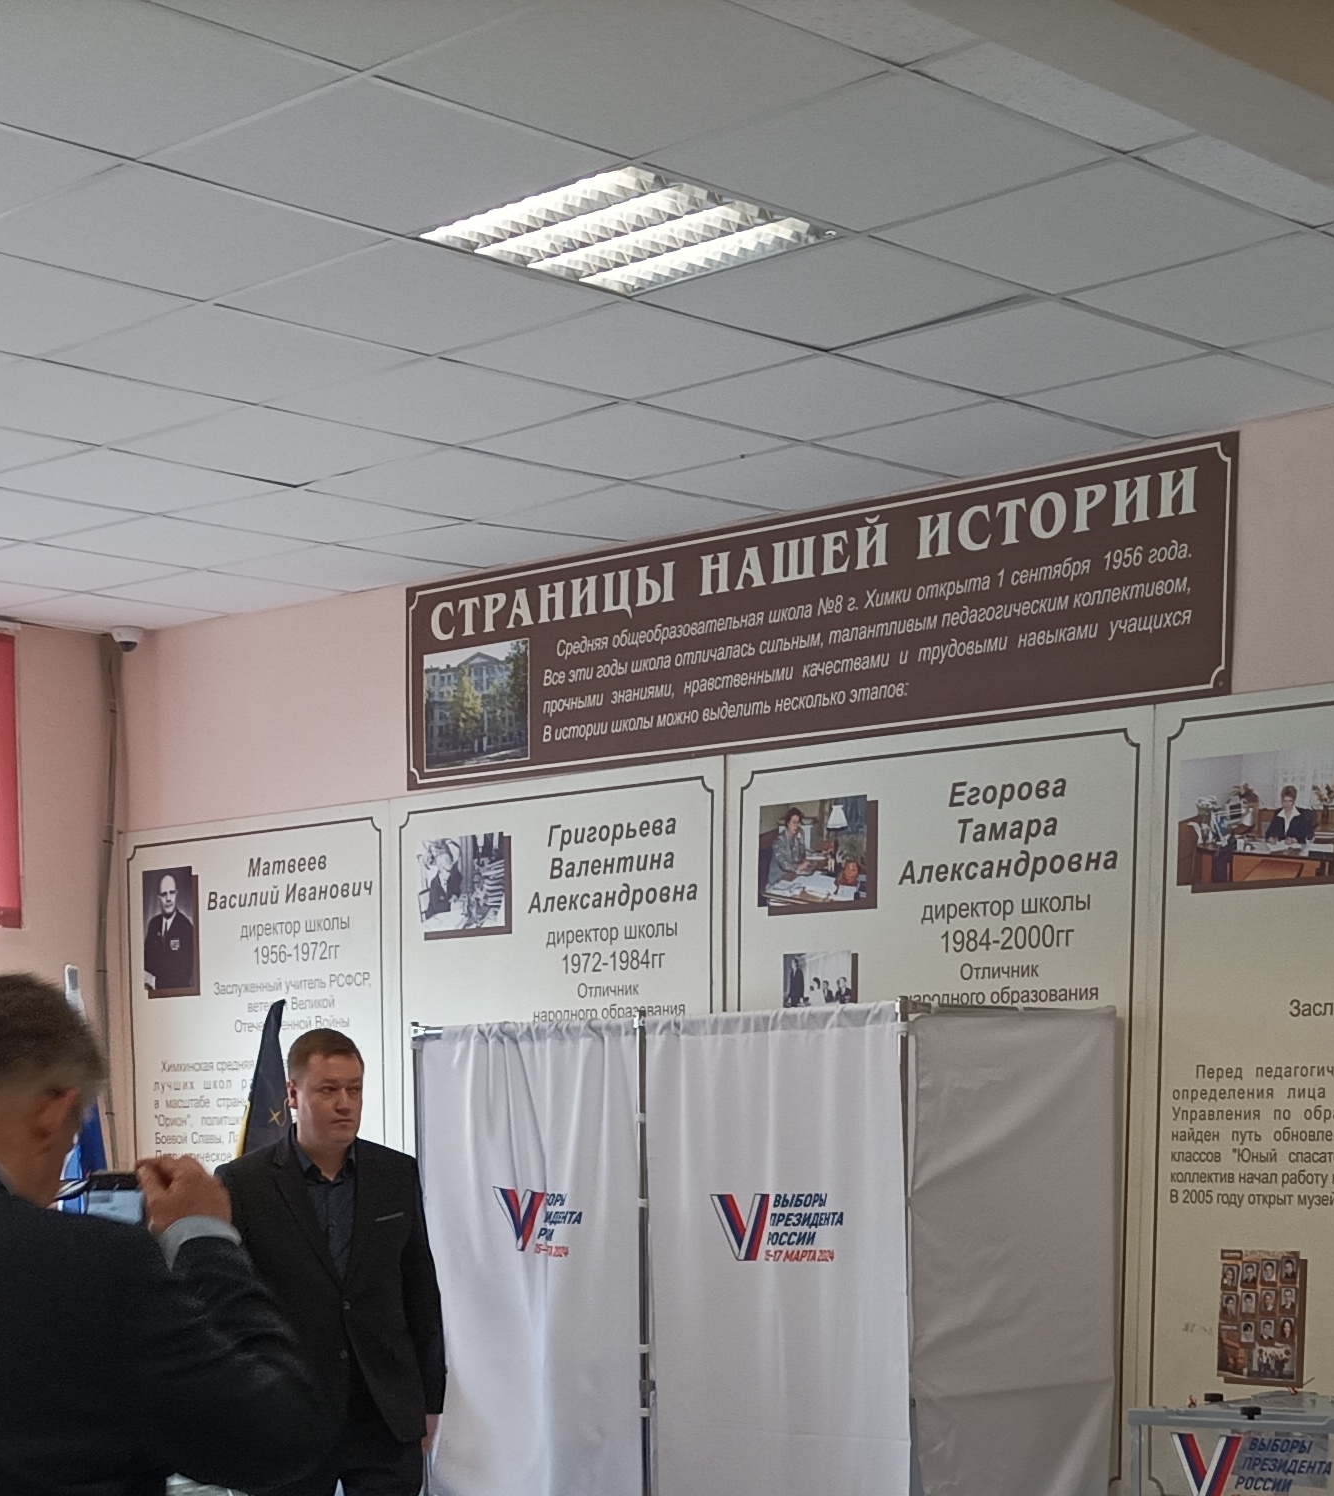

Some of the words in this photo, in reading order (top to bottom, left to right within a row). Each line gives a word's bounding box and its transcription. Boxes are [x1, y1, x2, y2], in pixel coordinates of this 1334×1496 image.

[430, 560, 677, 642] СТРАНИЦЫ
[699, 517, 889, 596] НАШЕЙ
[916, 466, 1199, 560] ИСТОРИИ
[557, 636, 608, 660] Средняя
[612, 612, 767, 654] общеобразовательная
[768, 604, 812, 623] школа
[817, 595, 843, 616] №8
[864, 588, 911, 609] Химки
[916, 575, 990, 601] открыта
[1011, 557, 1091, 586] сентября
[1104, 546, 1143, 571] 1956
[1148, 540, 1192, 564] года.
[543, 669, 565, 686] Все
[568, 667, 594, 682] эти
[596, 659, 628, 678] годы
[631, 655, 671, 673] школа
[675, 643, 755, 667] отличалась
[759, 633, 823, 654] сильным,
[829, 615, 938, 644] талантливым
[941, 595, 1069, 627] педагогическим
[1073, 577, 1191, 608] коллективом,
[543, 693, 604, 717] прочными
[611, 683, 674, 704] знаниями,
[684, 666, 793, 698] нравственными
[802, 653, 890, 678] качествами
[918, 636, 1008, 665] трудовыми
[1018, 623, 1098, 648] навыками
[1108, 609, 1192, 641] учащихся
[555, 722, 608, 741] истории
[611, 716, 654, 733] школы
[656, 710, 699, 727] можно
[702, 701, 771, 722] выделить
[775, 691, 846, 712] несколько
[849, 682, 909, 703] этапов:
[948, 778, 1066, 809] Егорова
[548, 818, 676, 851] Григорьева
[958, 817, 1057, 845] Тамара
[248, 855, 327, 877] Матвеев
[550, 852, 674, 879] Валентина
[898, 850, 1118, 885] Александровна
[208, 885, 279, 910] Василий
[285, 881, 373, 903] Иванович
[528, 883, 697, 914] Александровна
[921, 899, 1014, 924] директор
[1021, 894, 1091, 914] школы
[240, 920, 301, 940] директор
[305, 916, 350, 933] школы
[546, 926, 619, 948] директор
[624, 922, 677, 939] школы
[941, 924, 1075, 953] 1984-2000гг
[254, 941, 340, 965] 1956-1972гг
[562, 949, 666, 974] 1972-1984гг
[960, 963, 1039, 980] Отличник
[214, 981, 282, 997] Заслуженный
[285, 978, 326, 992] учитель
[577, 983, 639, 998] Отличник
[990, 986, 1099, 1006] образования
[291, 995, 335, 1010] Великой
[315, 1015, 350, 1029] Войны
[1196, 1064, 1243, 1082] Перед
[153, 1080, 195, 1094] лучших
[203, 1079, 232, 1090] школ
[1172, 1088, 1274, 1103] определения
[1287, 1087, 1326, 1101] лица
[1172, 1106, 1260, 1124] Управления
[1171, 1128, 1220, 1143] найден
[1232, 1131, 1262, 1145] путь
[1171, 1151, 1221, 1163] классов
[1232, 1148, 1277, 1163] "Юный
[1170, 1172, 1235, 1183] коллектив
[1239, 1173, 1278, 1184] начал
[1281, 1169, 1328, 1188] работу
[773, 1192, 828, 1208] ВЫБОРЫ
[1182, 1189, 1213, 1204] 2005
[1217, 1193, 1244, 1208] году
[1248, 1194, 1294, 1208] открыт
[769, 1211, 844, 1229] ПРЕЗИДЕНТА
[1248, 1437, 1314, 1455] ВЫБОРЫ
[1241, 1456, 1333, 1476] ПРЕЗИДЕНТА
[1235, 1475, 1293, 1493] РОССИИ
